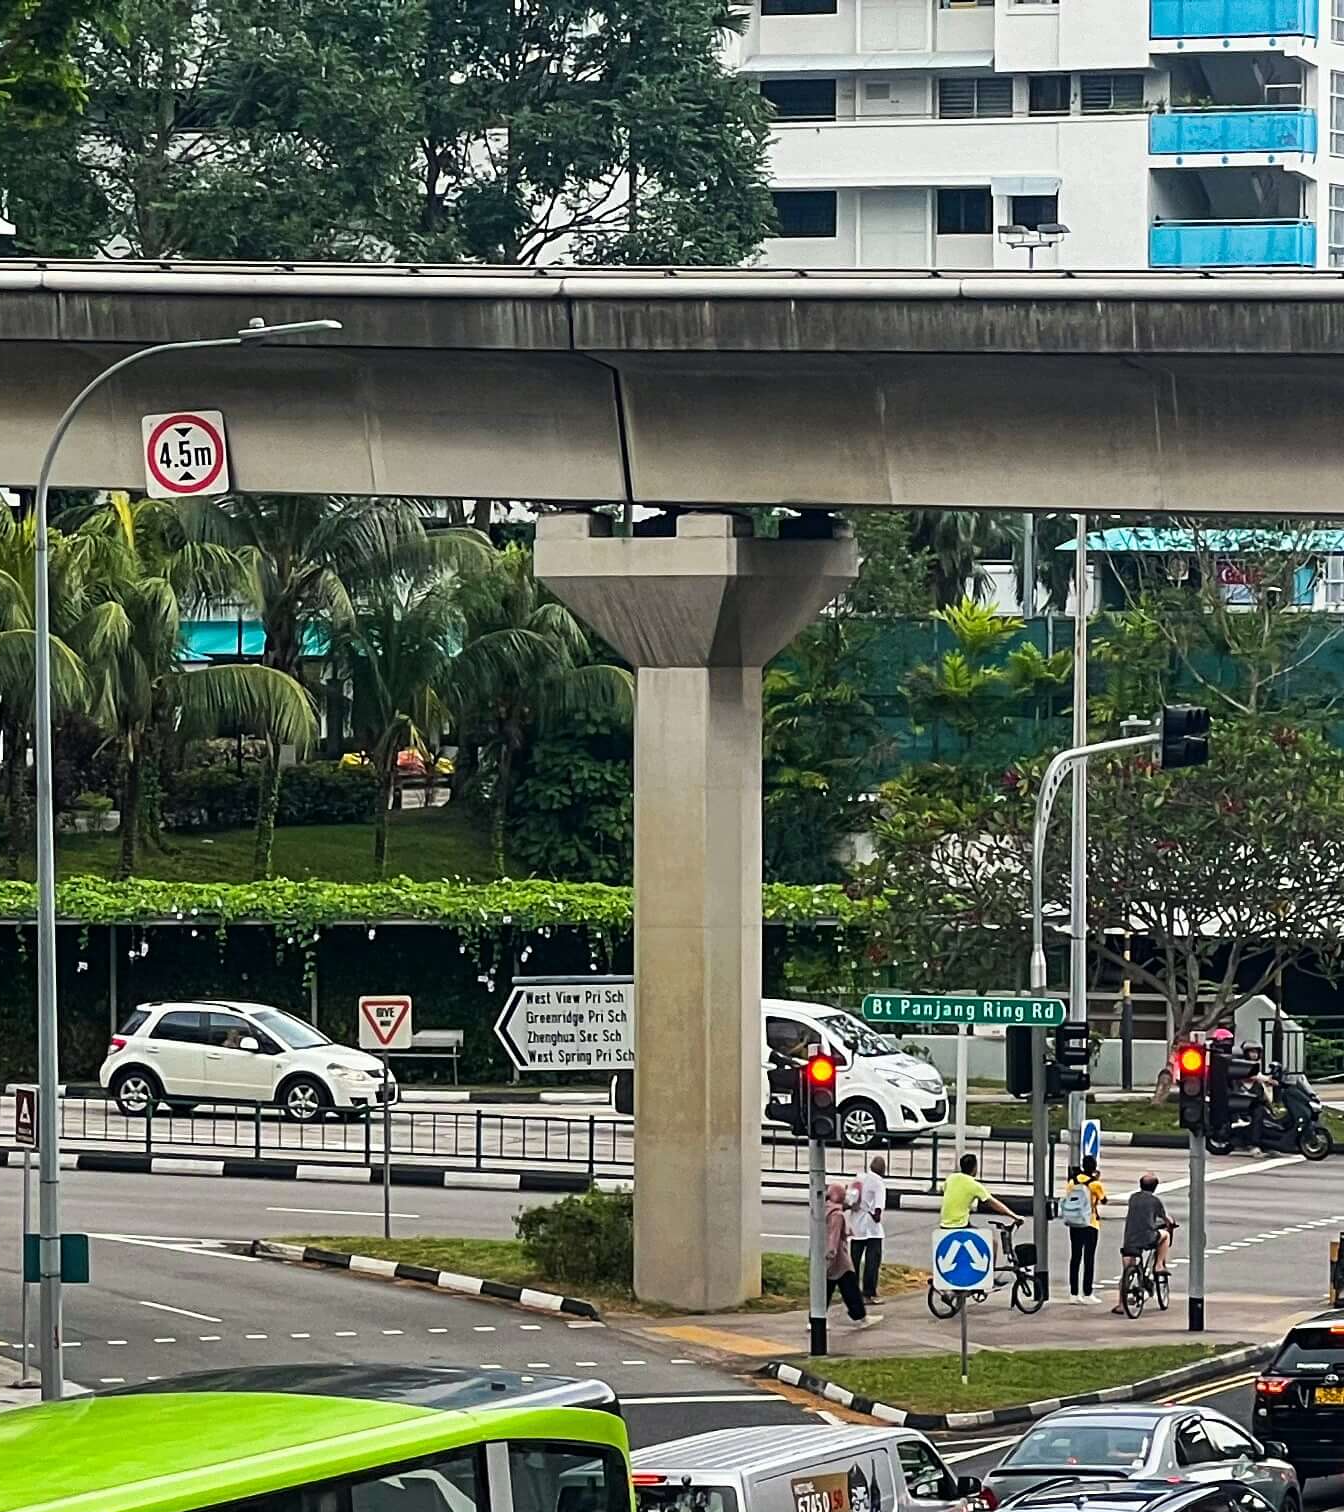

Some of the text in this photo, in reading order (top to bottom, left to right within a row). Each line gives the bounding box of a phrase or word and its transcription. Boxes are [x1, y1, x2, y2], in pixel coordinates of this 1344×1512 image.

[159, 440, 212, 468] 4.5m
[526, 990, 624, 1004] West View Pri Sch
[526, 1009, 627, 1026] Greenridge Pri Sch
[872, 999, 1054, 1021] Bt Panjang Ring Rd
[528, 1029, 622, 1046] Zhenghua Sec Sch
[529, 1049, 634, 1065] West Spring Pri Sch
